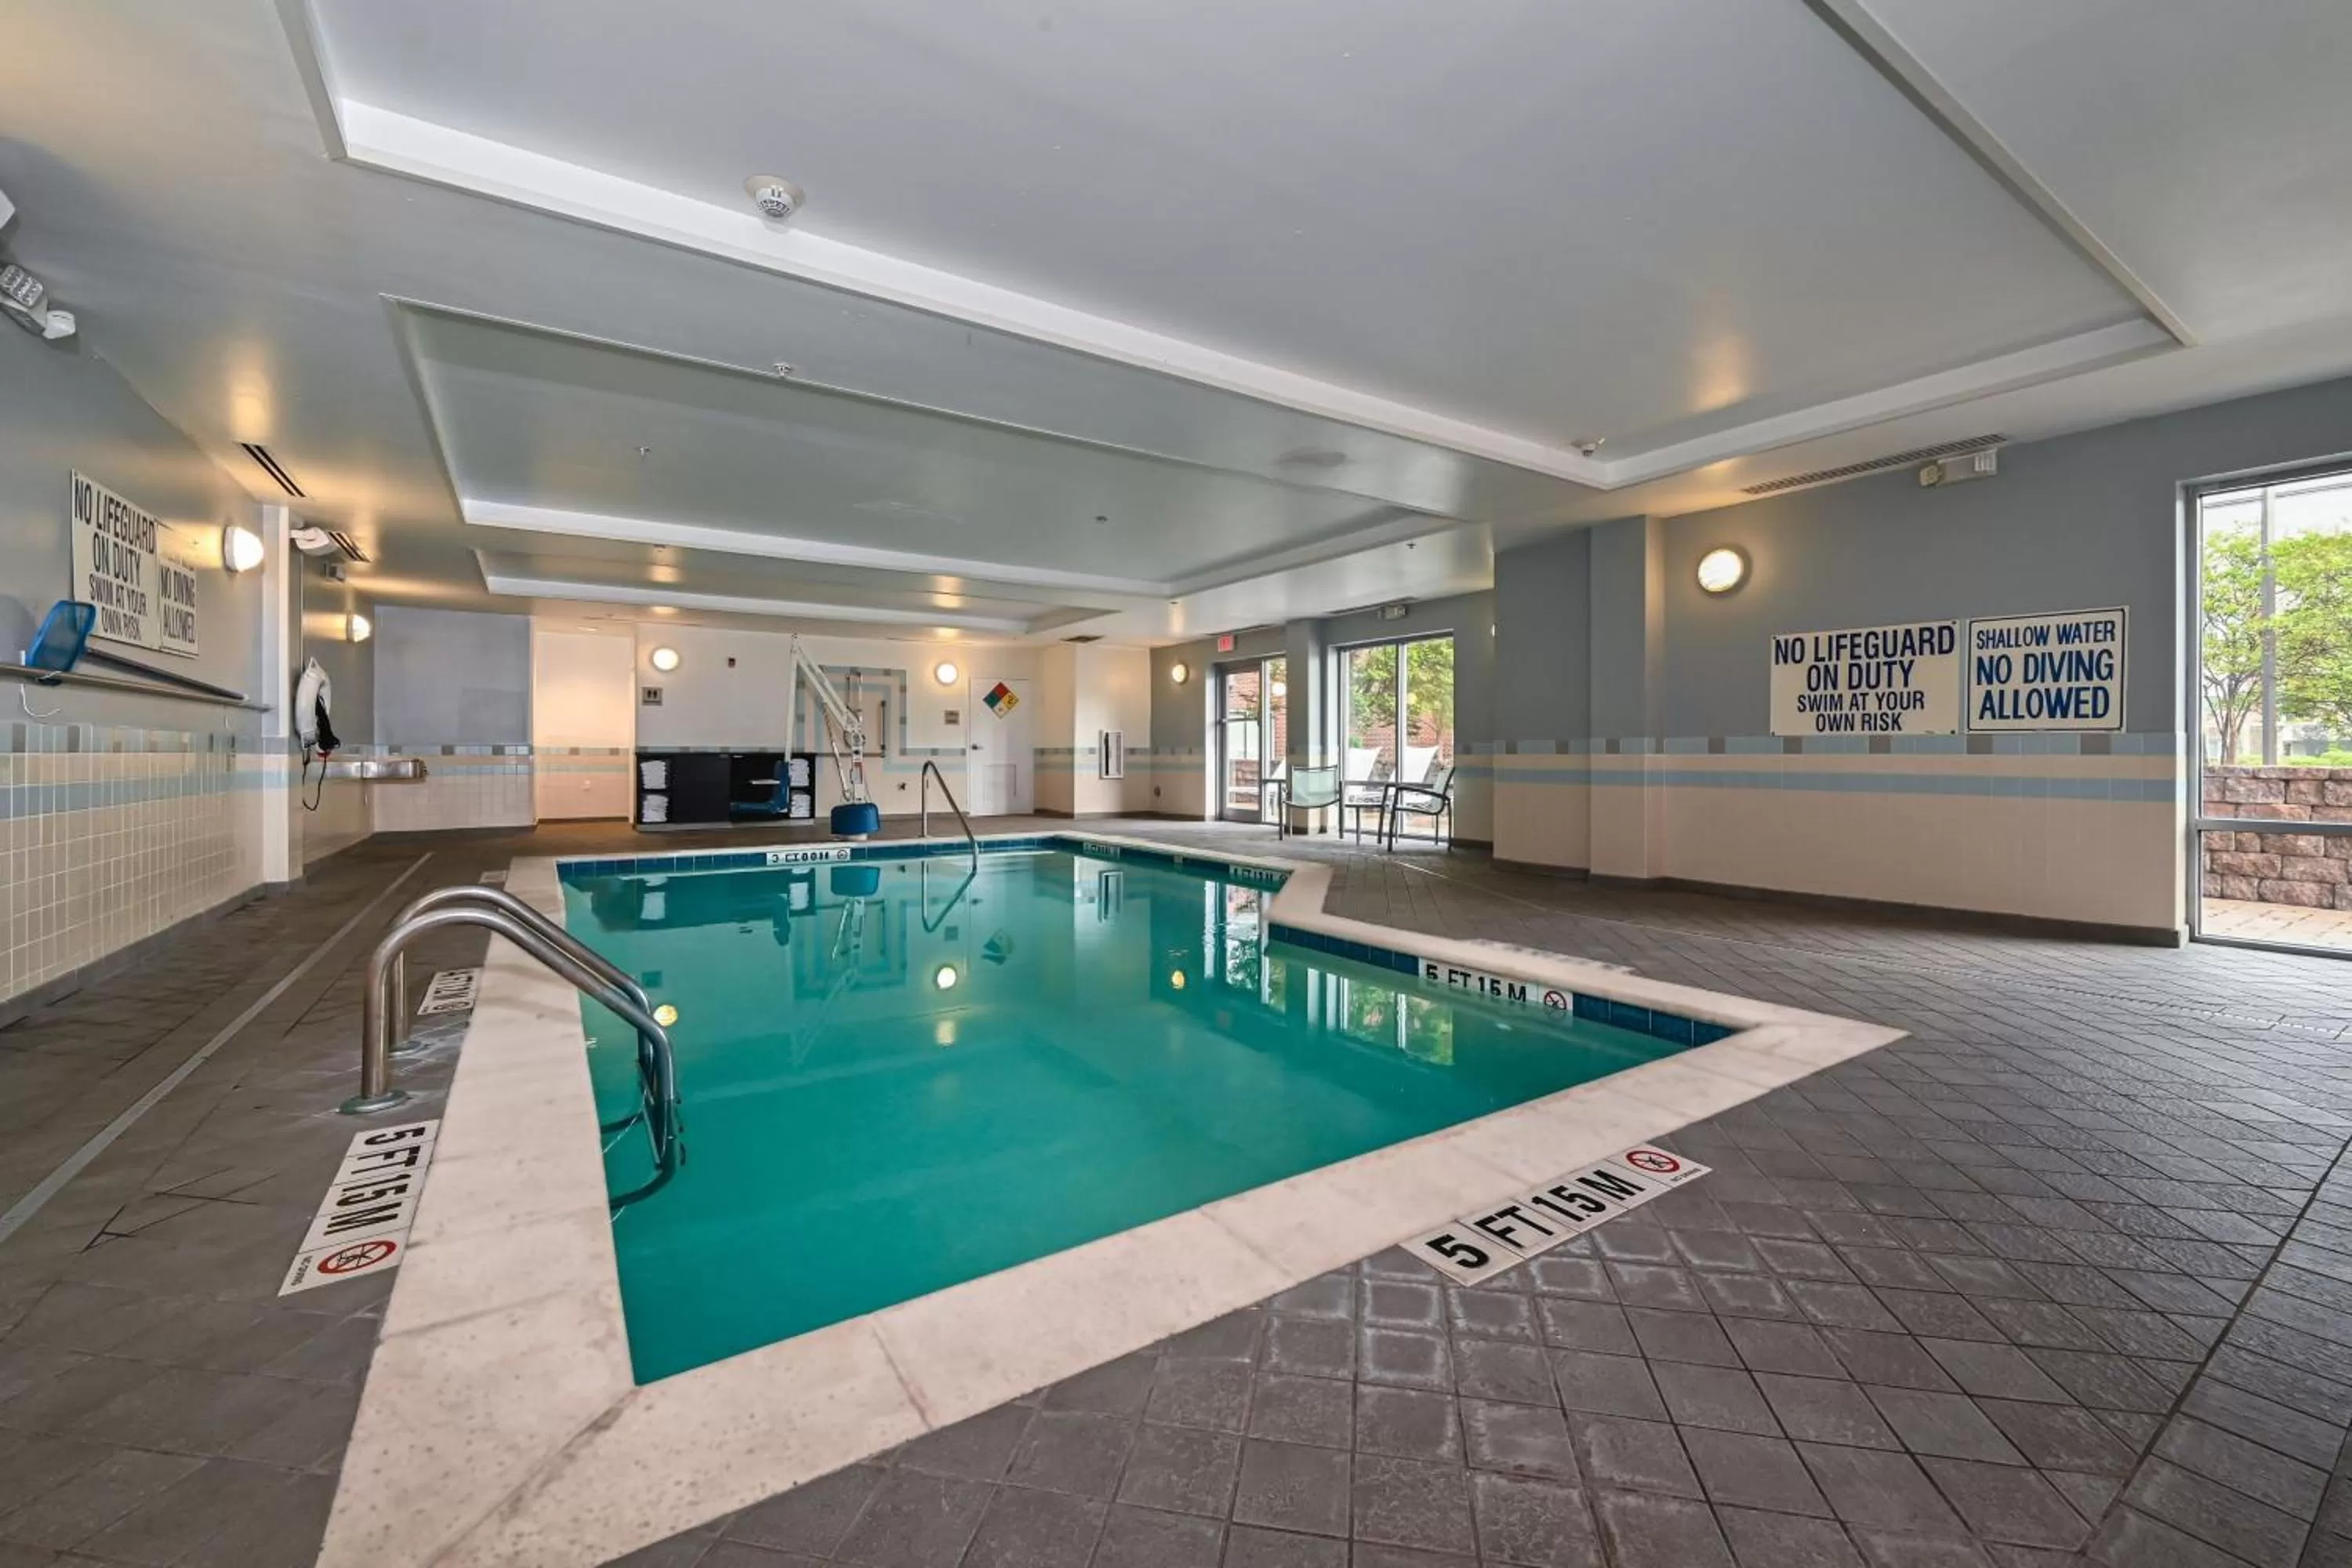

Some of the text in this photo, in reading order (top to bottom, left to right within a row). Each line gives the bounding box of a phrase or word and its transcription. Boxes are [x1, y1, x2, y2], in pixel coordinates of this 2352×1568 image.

[75, 478, 155, 555] NO LIFEGUARD
[93, 532, 110, 575] ON
[113, 540, 141, 587] DUTY
[89, 573, 114, 605] SWIM
[116, 584, 125, 609] AT
[161, 565, 172, 600] NO
[1774, 626, 1955, 665] NO LIFEGUARD
[1976, 620, 2116, 650] SHALLOW WATER
[1807, 659, 1915, 691] ON DUTY
[1976, 649, 2114, 686] NO DIVING
[1797, 691, 1925, 713] SWIM AT YOUR
[1979, 686, 2110, 720] ALLOWED
[1815, 713, 1902, 732] OWN RISK
[1426, 964, 1439, 980] 5
[1448, 968, 1472, 989] FT
[1508, 983, 1527, 1003] M
[364, 1127, 426, 1145] 5
[351, 1145, 421, 1175] FT
[323, 1201, 402, 1236] M
[1425, 1234, 1490, 1269] 5
[1473, 1205, 1555, 1250] FT
[1575, 1169, 1646, 1201] M
